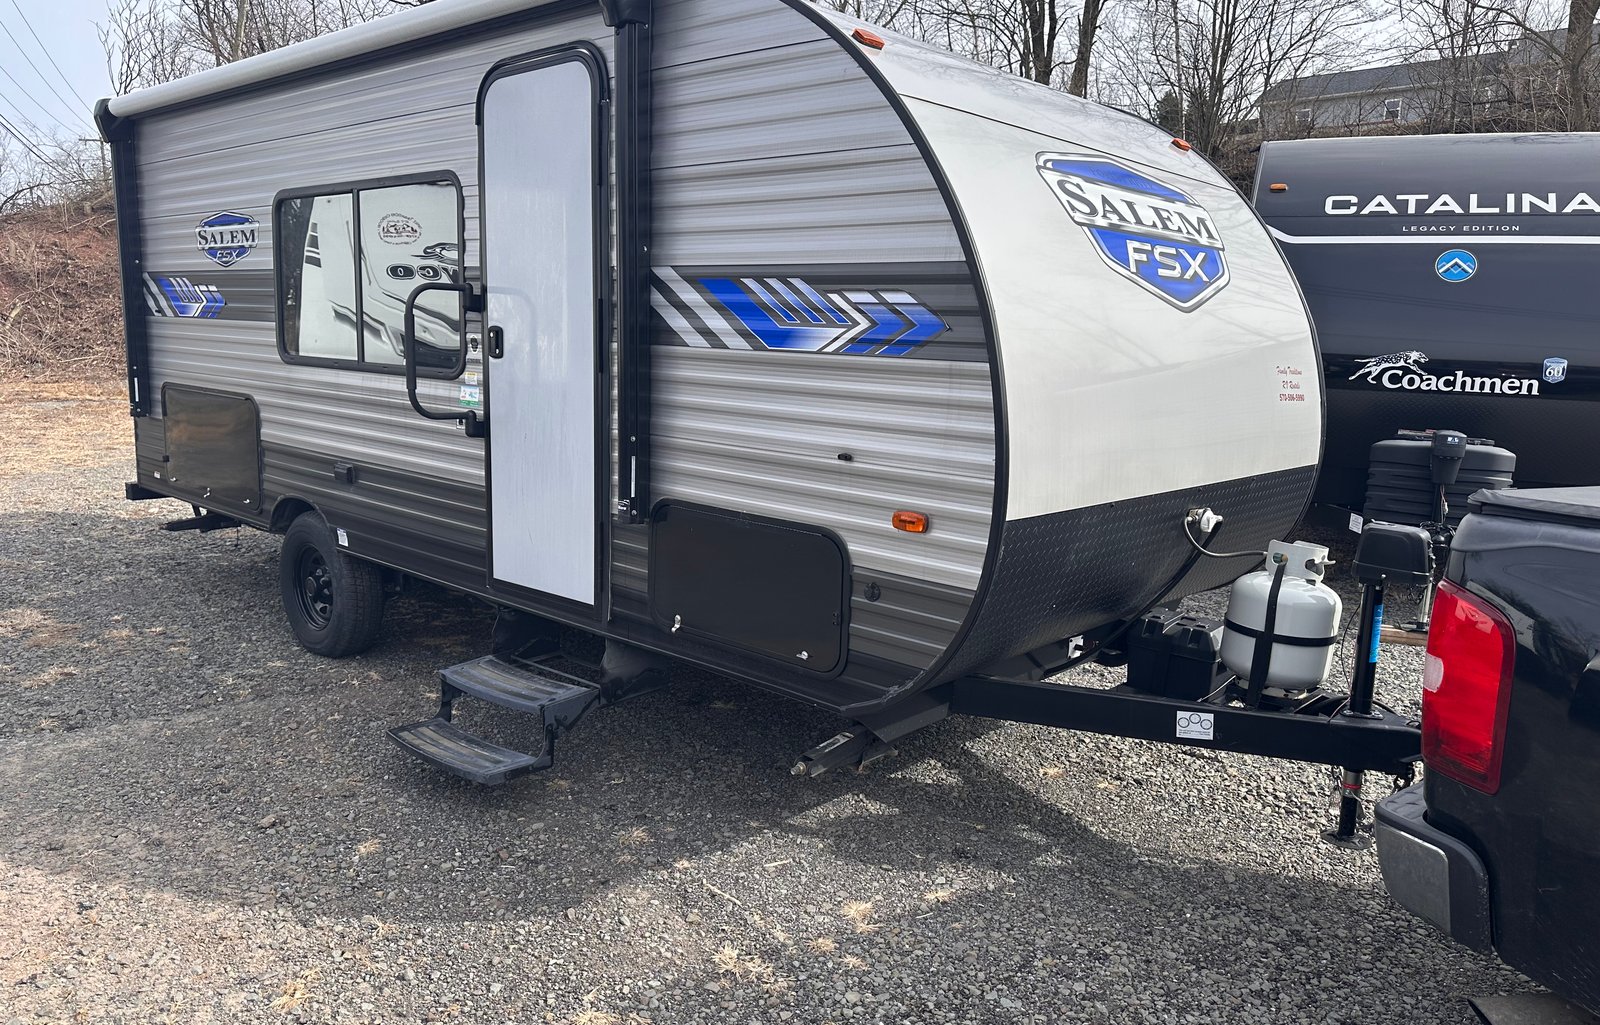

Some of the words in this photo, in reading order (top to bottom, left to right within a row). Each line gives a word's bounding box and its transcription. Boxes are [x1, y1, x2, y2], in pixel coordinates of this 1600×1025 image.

[1056, 179, 1219, 241] SALEM
[1324, 192, 1600, 215] CATALINA
[197, 229, 256, 246] SALEM
[215, 249, 240, 261] FSX
[1126, 240, 1211, 283] FSX
[1381, 369, 1540, 396] Coachmen
